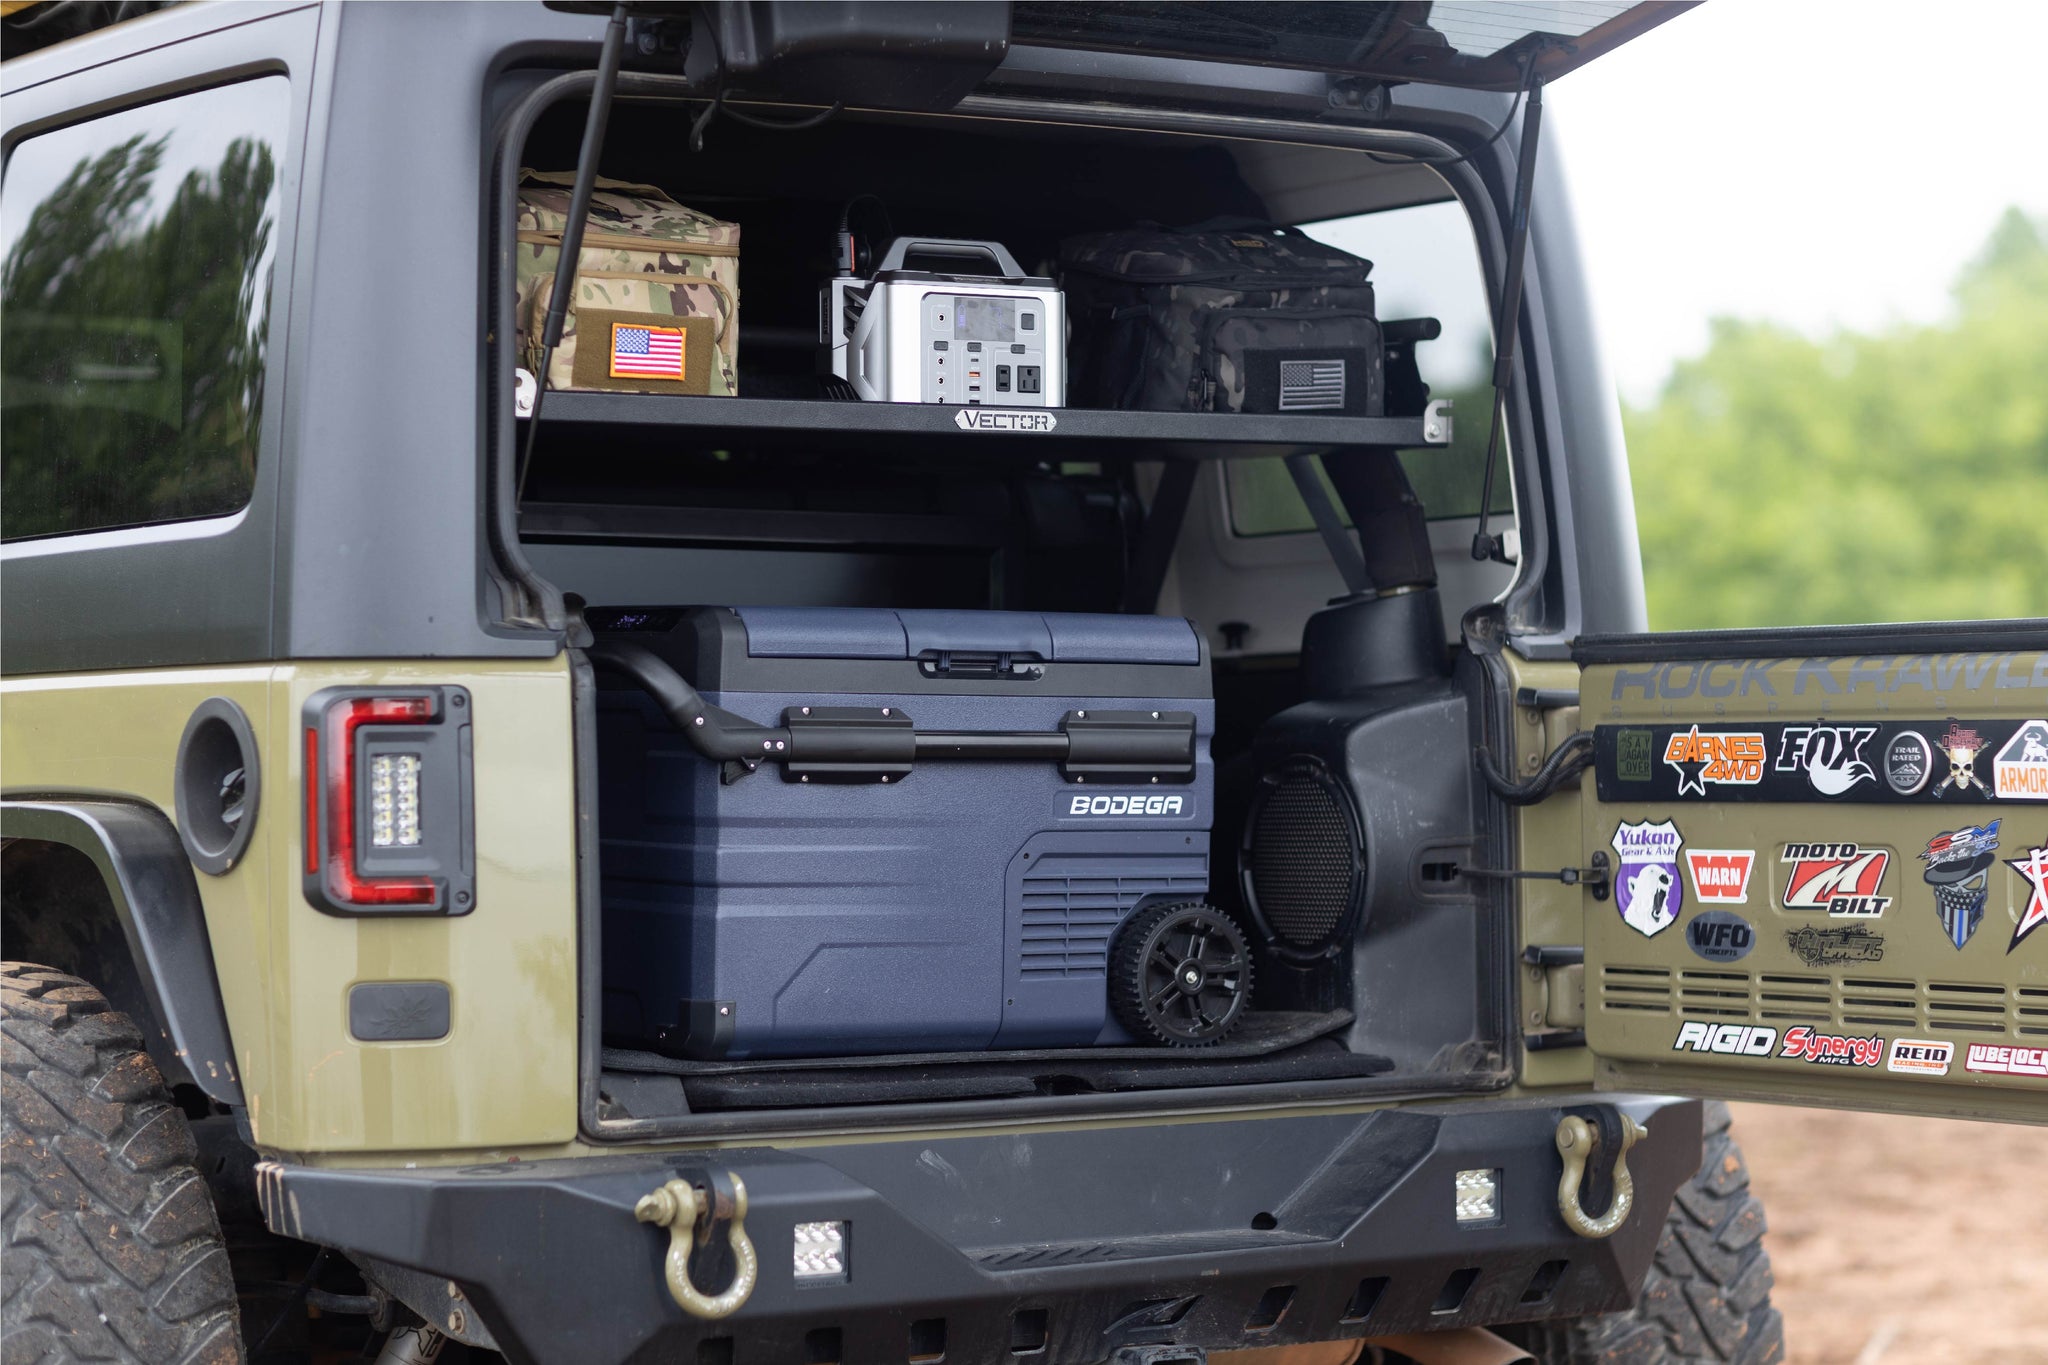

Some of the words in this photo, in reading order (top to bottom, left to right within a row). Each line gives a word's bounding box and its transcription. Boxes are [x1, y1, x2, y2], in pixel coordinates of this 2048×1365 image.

[963, 410, 1048, 430] VECTOR
[1627, 735, 1650, 748] SAY
[1666, 728, 1763, 762] BARNES
[1775, 727, 1877, 771] FOX
[1892, 754, 1921, 762] RATED
[1895, 746, 1920, 754] TRAIL
[1626, 761, 1650, 773] OVER
[1704, 760, 1761, 780] 4WD
[1069, 795, 1183, 815] BODEGA
[1620, 829, 1675, 846] Yukon
[1622, 848, 1643, 857] Gear
[1655, 846, 1675, 856] Axle
[1784, 844, 1857, 858] MOTO
[1698, 867, 1741, 886] WARN
[1829, 898, 1888, 914] BILT
[1693, 922, 1750, 948] WFO
[1705, 948, 1737, 957] CONCEPTS
[1675, 1022, 1777, 1056] RIGID
[1780, 1027, 1884, 1067] Synergy
[1817, 1056, 1850, 1065] MFG
[1895, 1047, 1947, 1062] REID
